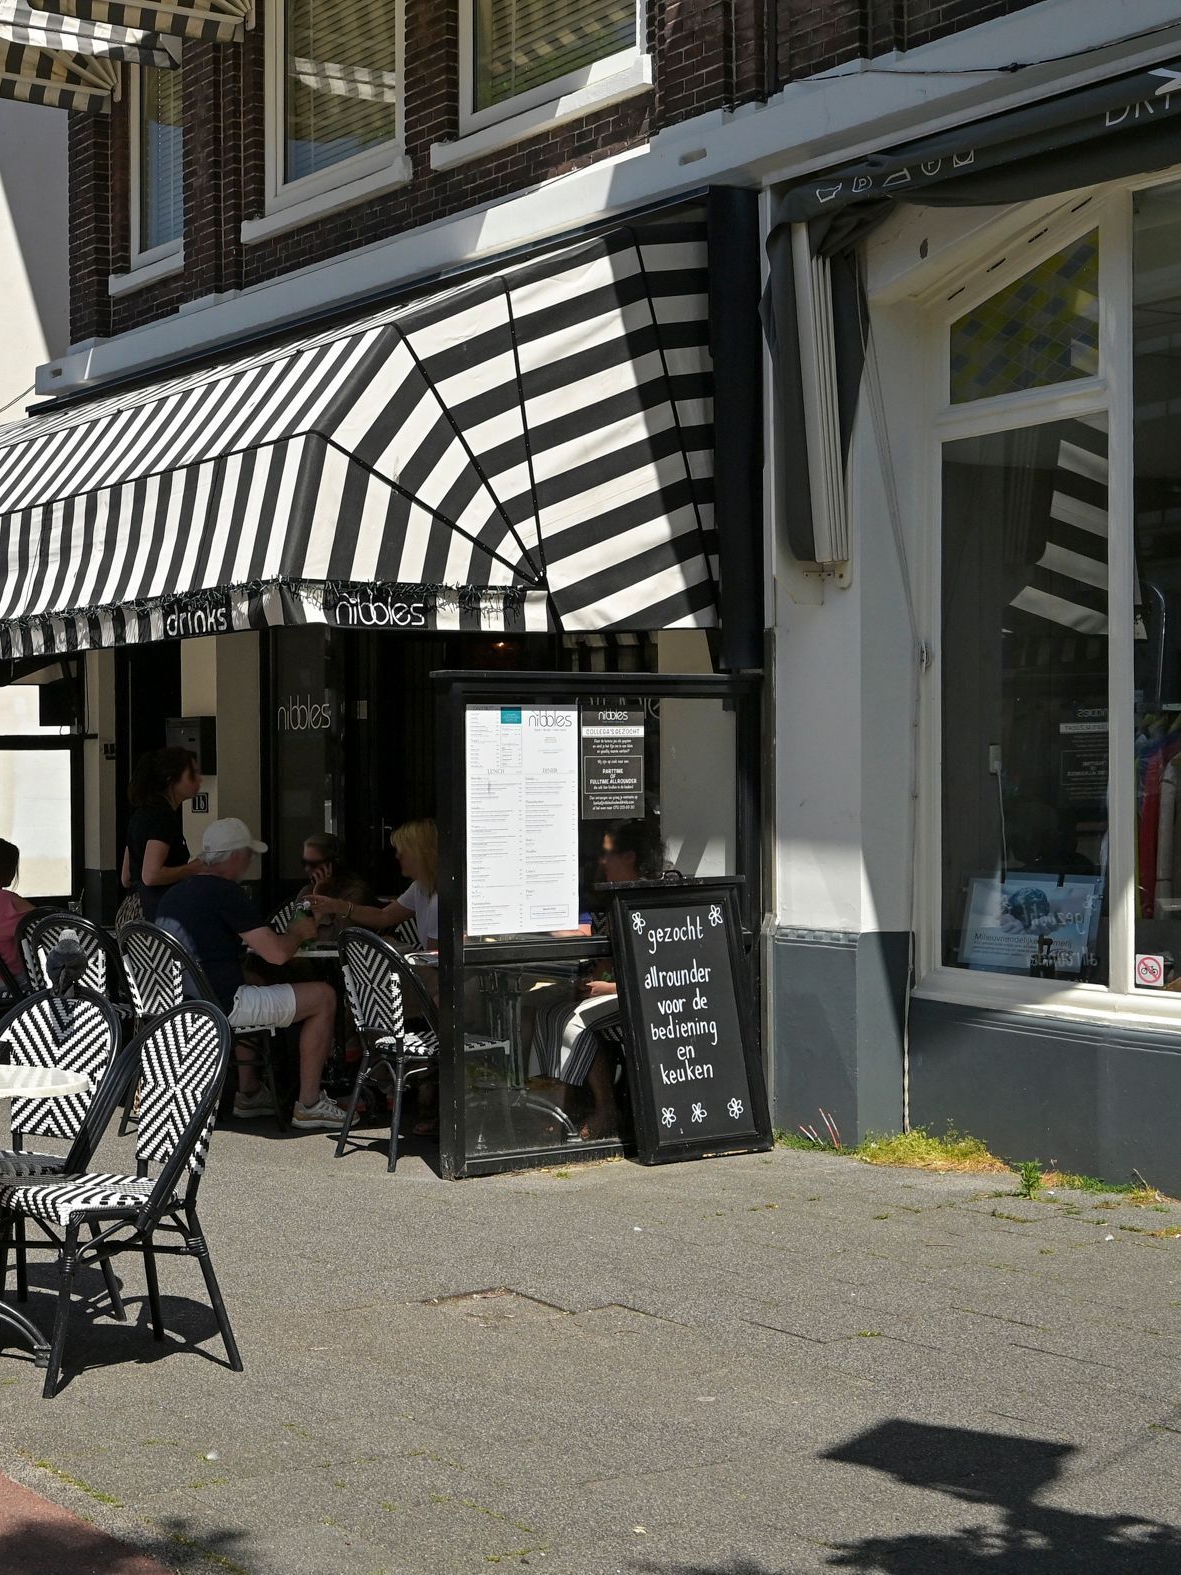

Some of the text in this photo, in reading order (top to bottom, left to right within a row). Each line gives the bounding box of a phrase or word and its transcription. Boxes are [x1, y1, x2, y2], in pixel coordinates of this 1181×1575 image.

[166, 599, 227, 636] drinks
[336, 590, 425, 626] nibbles
[278, 694, 331, 730] nibbles
[529, 710, 572, 727] nibbles
[598, 709, 628, 720] nibbles
[648, 915, 704, 955] gezocht
[644, 958, 711, 989] allrounder
[657, 988, 708, 1015] voor de
[651, 1015, 718, 1046] bediening
[677, 1044, 695, 1061] en
[660, 1059, 714, 1085] keuken
